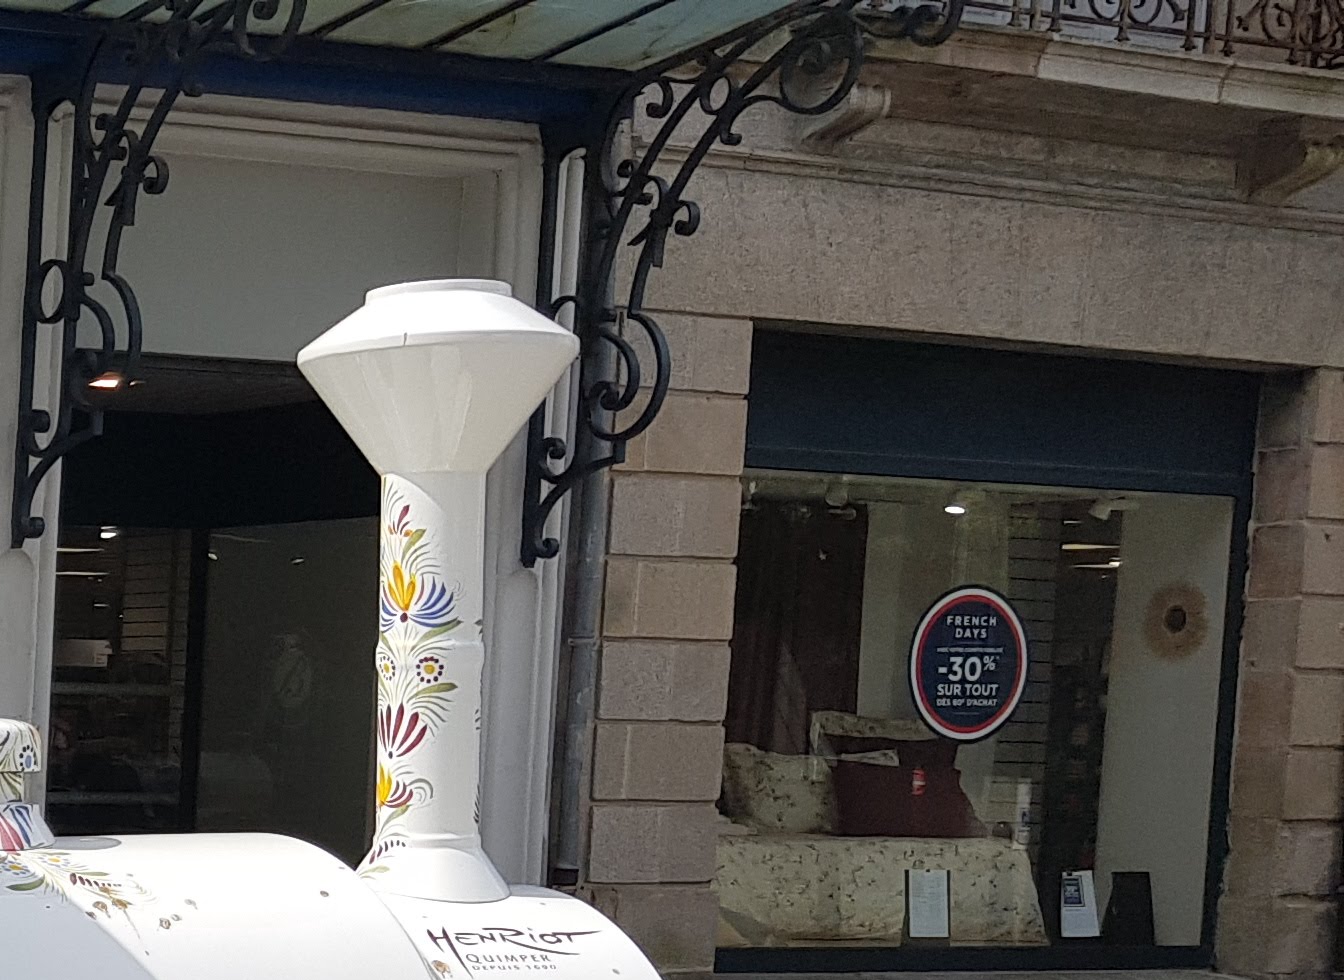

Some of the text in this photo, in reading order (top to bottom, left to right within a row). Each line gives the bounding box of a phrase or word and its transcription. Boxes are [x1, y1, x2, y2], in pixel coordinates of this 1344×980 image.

[946, 615, 997, 627] FRENCH
[955, 628, 987, 639] DAYS
[936, 683, 999, 696] SUR TOUT
[465, 953, 551, 964] QUIMPER
